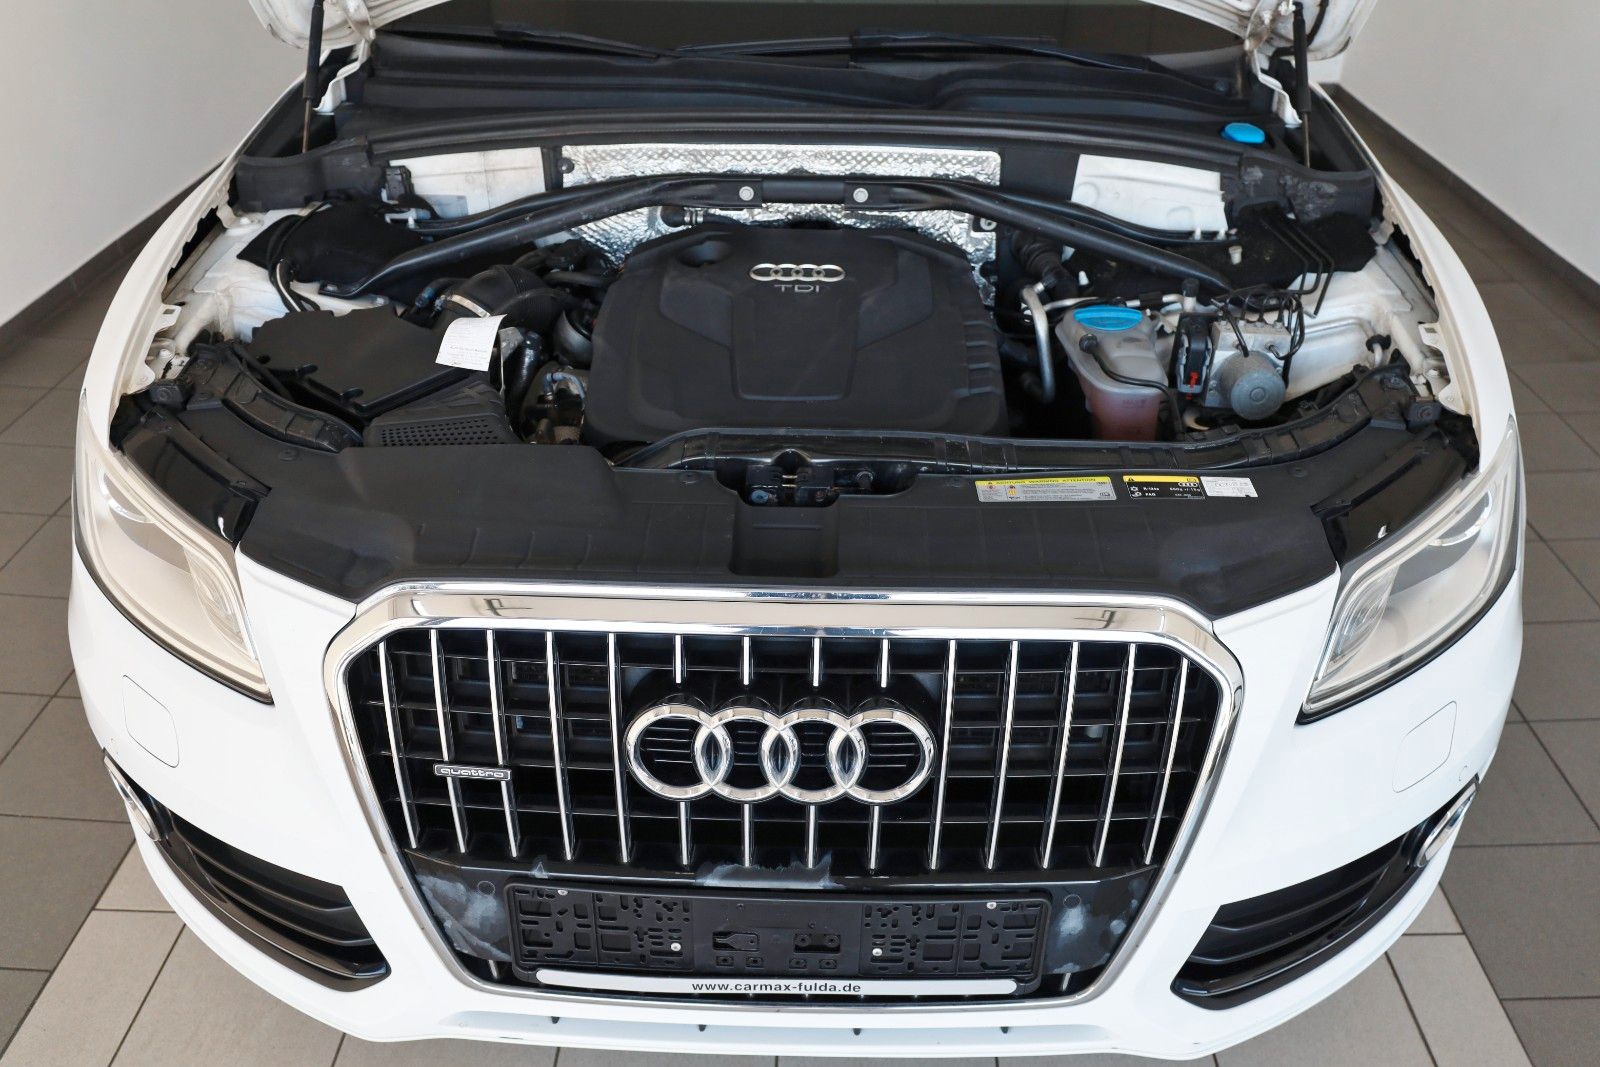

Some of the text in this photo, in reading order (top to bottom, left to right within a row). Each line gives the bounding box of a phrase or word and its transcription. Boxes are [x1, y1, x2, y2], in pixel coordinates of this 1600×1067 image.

[774, 284, 820, 293] TDI
[440, 768, 504, 778] quattro
[691, 982, 861, 993] www.carmax-fulda.de
